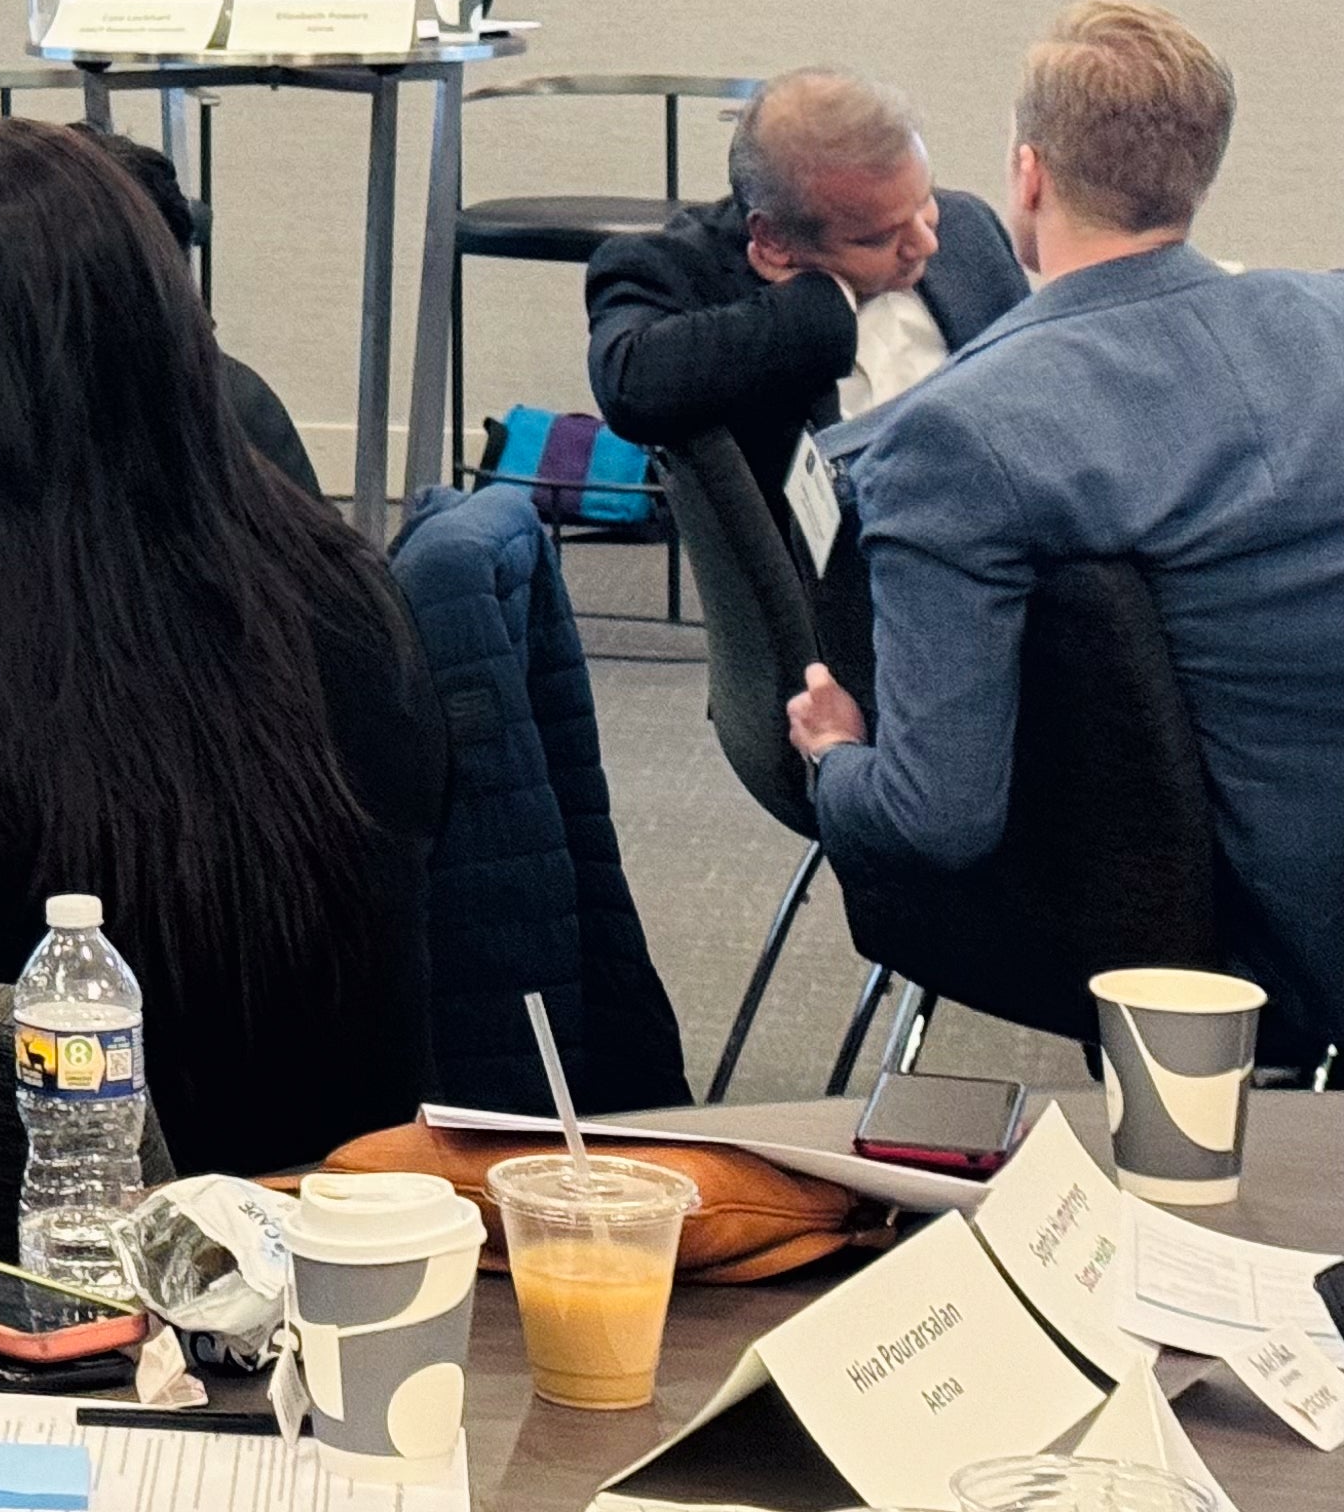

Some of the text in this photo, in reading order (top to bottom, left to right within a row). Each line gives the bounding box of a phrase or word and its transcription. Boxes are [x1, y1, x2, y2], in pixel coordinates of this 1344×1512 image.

[845, 1301, 964, 1395] Hiva Pourarsalan
[920, 1376, 965, 1416] Aetna
